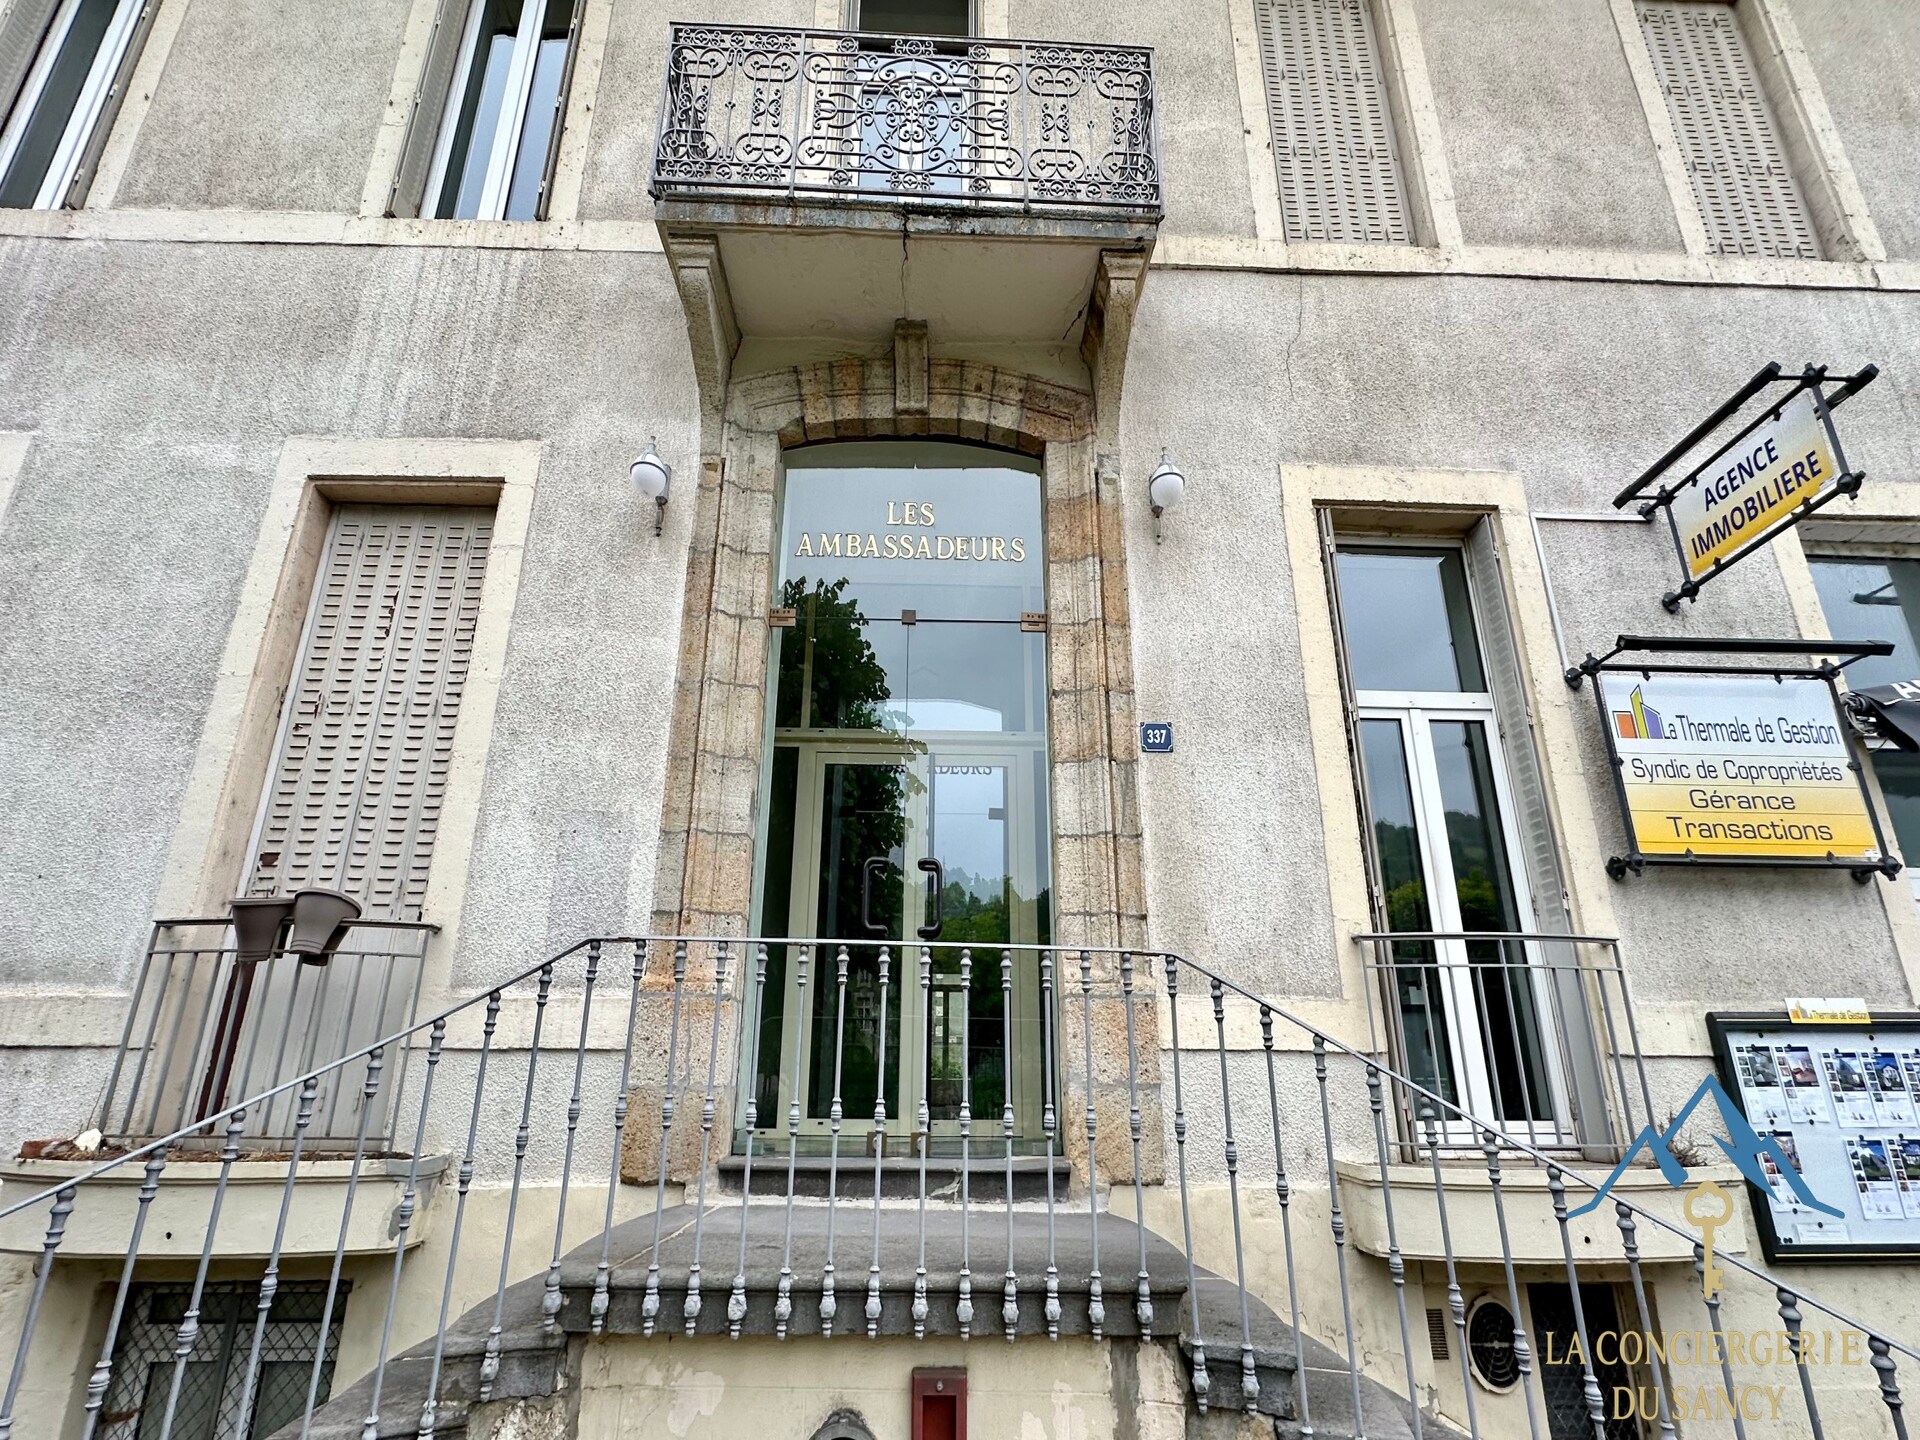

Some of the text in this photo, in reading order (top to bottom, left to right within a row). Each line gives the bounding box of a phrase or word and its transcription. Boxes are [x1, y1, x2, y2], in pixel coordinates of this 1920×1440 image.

[1704, 437, 1779, 512] AGENCE
[886, 501, 936, 527] LES
[1691, 450, 1822, 559] IMMOBILIERE
[795, 533, 1026, 562] AMBASSADEURS
[1147, 729, 1167, 744] 337
[1659, 715, 1841, 745] La Thermale de Gestion
[1631, 758, 1843, 785] Syndic de Copropriétés
[1689, 788, 1796, 810] Gérance
[1666, 816, 1833, 841] Transactions
